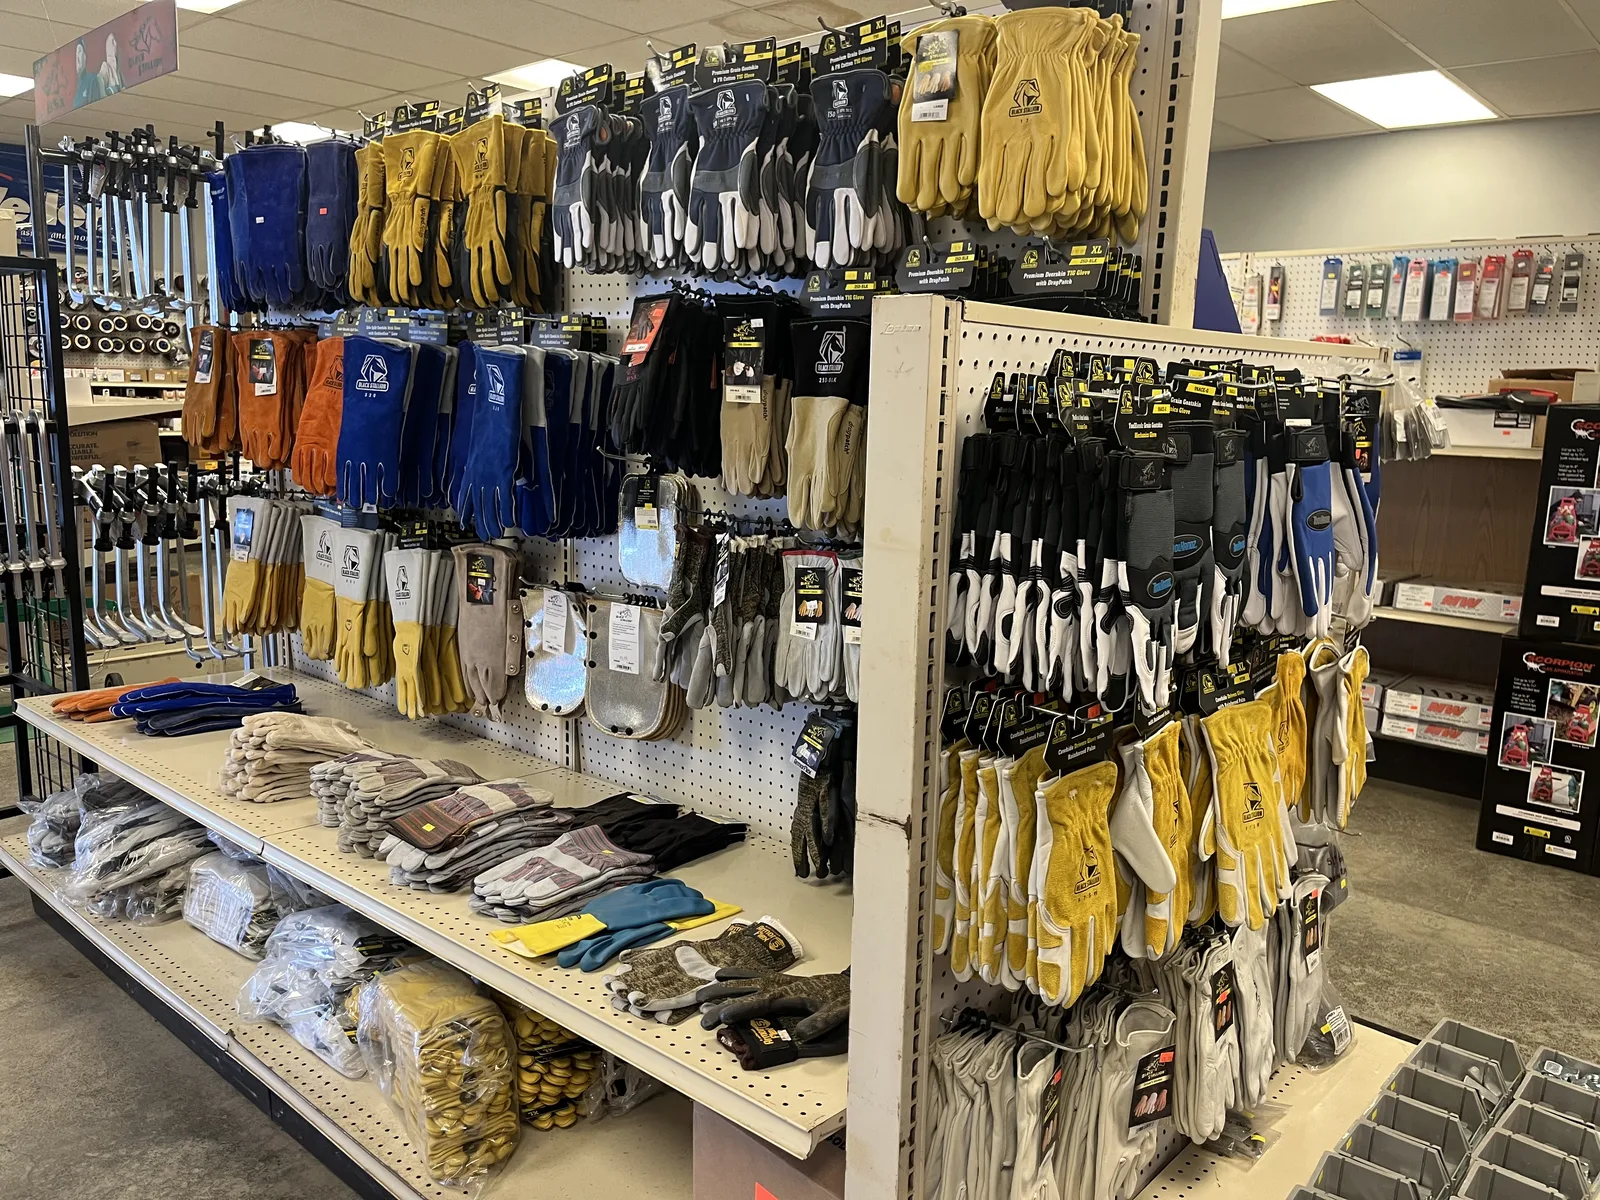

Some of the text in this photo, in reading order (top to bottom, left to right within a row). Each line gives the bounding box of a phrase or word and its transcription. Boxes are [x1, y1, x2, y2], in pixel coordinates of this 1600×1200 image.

[876, 20, 884, 29] XL
[890, 25, 899, 34] XL
[1023, 106, 1040, 114] STALLION
[968, 242, 973, 252] L
[1090, 246, 1102, 254] XL
[980, 249, 986, 258] L
[864, 272, 871, 280] M
[929, 276, 950, 284] DragPatch
[882, 280, 888, 288] M
[1048, 278, 1073, 287] DragPatch
[1183, 399, 1201, 407] Goatskin
[1528, 654, 1592, 670] SCORPION
[1058, 746, 1074, 756] Cowhide
[1068, 745, 1096, 760] Reinforced Palm
